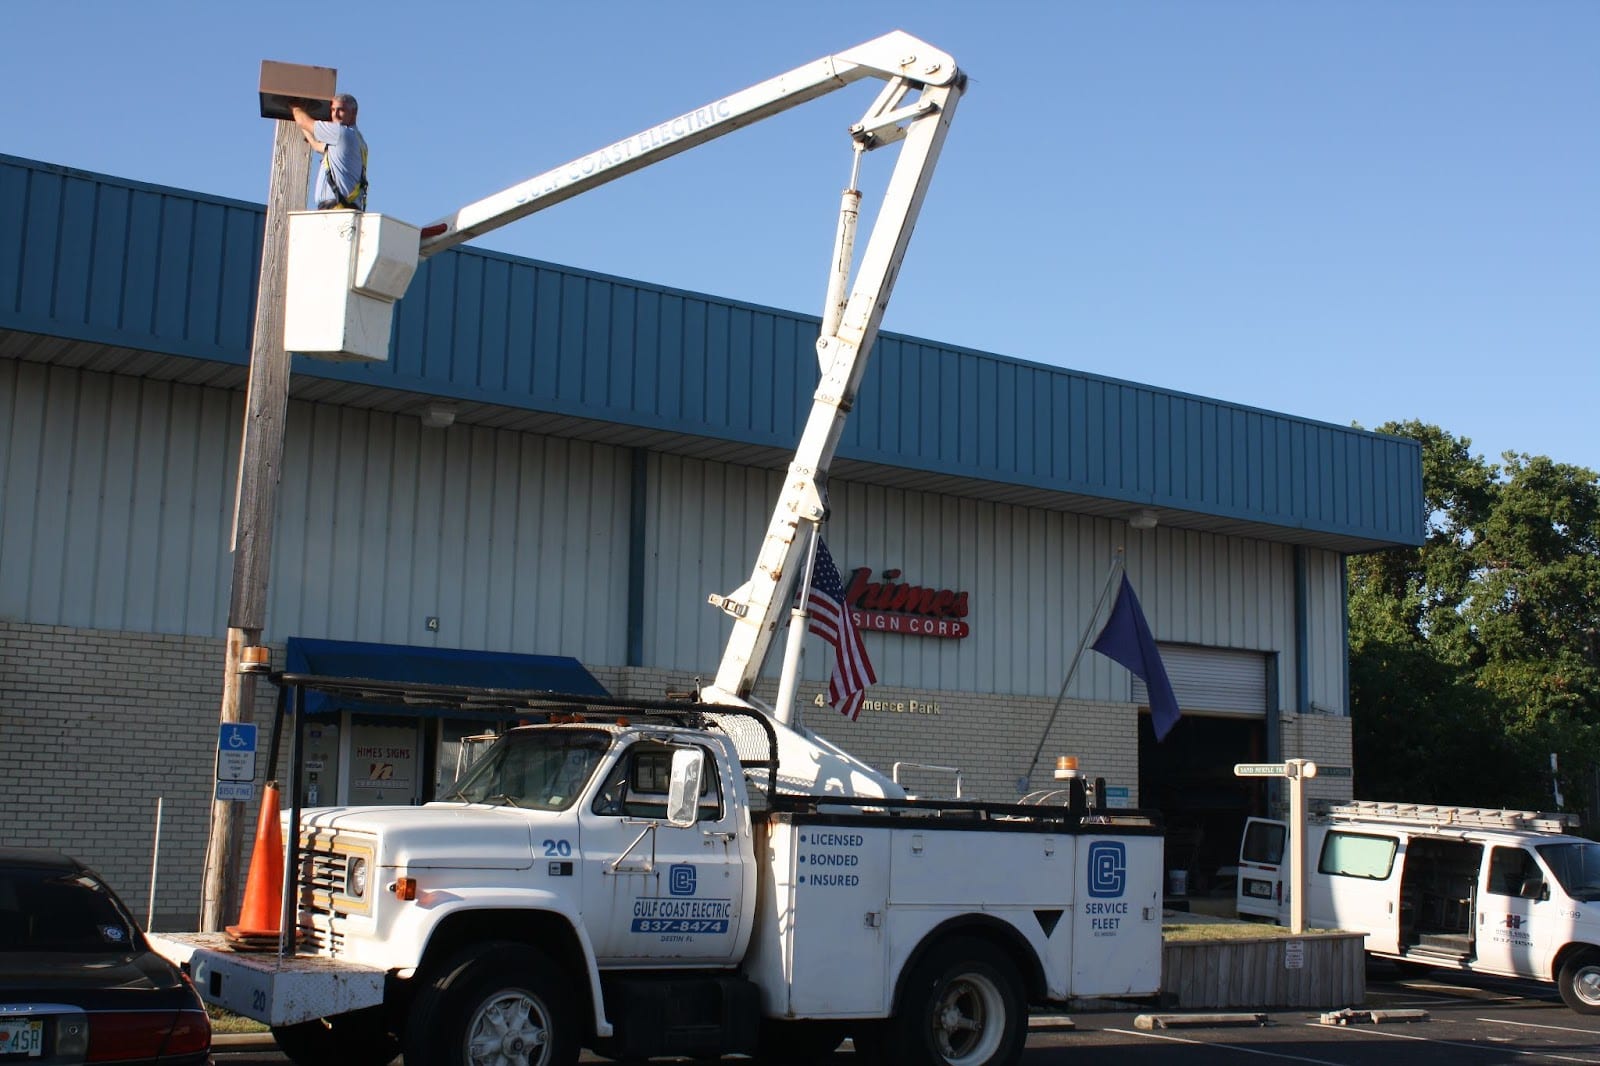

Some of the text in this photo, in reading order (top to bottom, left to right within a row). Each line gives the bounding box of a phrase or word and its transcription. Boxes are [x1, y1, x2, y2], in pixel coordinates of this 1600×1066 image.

[568, 139, 632, 180] COAST
[638, 100, 730, 152] ELECTRIC
[428, 618, 438, 630] 4
[851, 612, 963, 636] SIGN CORP.
[814, 693, 940, 715] 4 merce Park
[356, 746, 383, 759] HIMES
[810, 833, 864, 846] LICENSED
[542, 839, 572, 857] 20
[810, 853, 859, 866] BONDED
[810, 873, 859, 886] INSURED
[633, 901, 731, 919] GULF COAST ELECTRIC
[1085, 902, 1128, 914] SERVICE
[639, 920, 722, 932] 837-8474
[1091, 918, 1120, 930] FLEET
[253, 988, 266, 1012] 20
